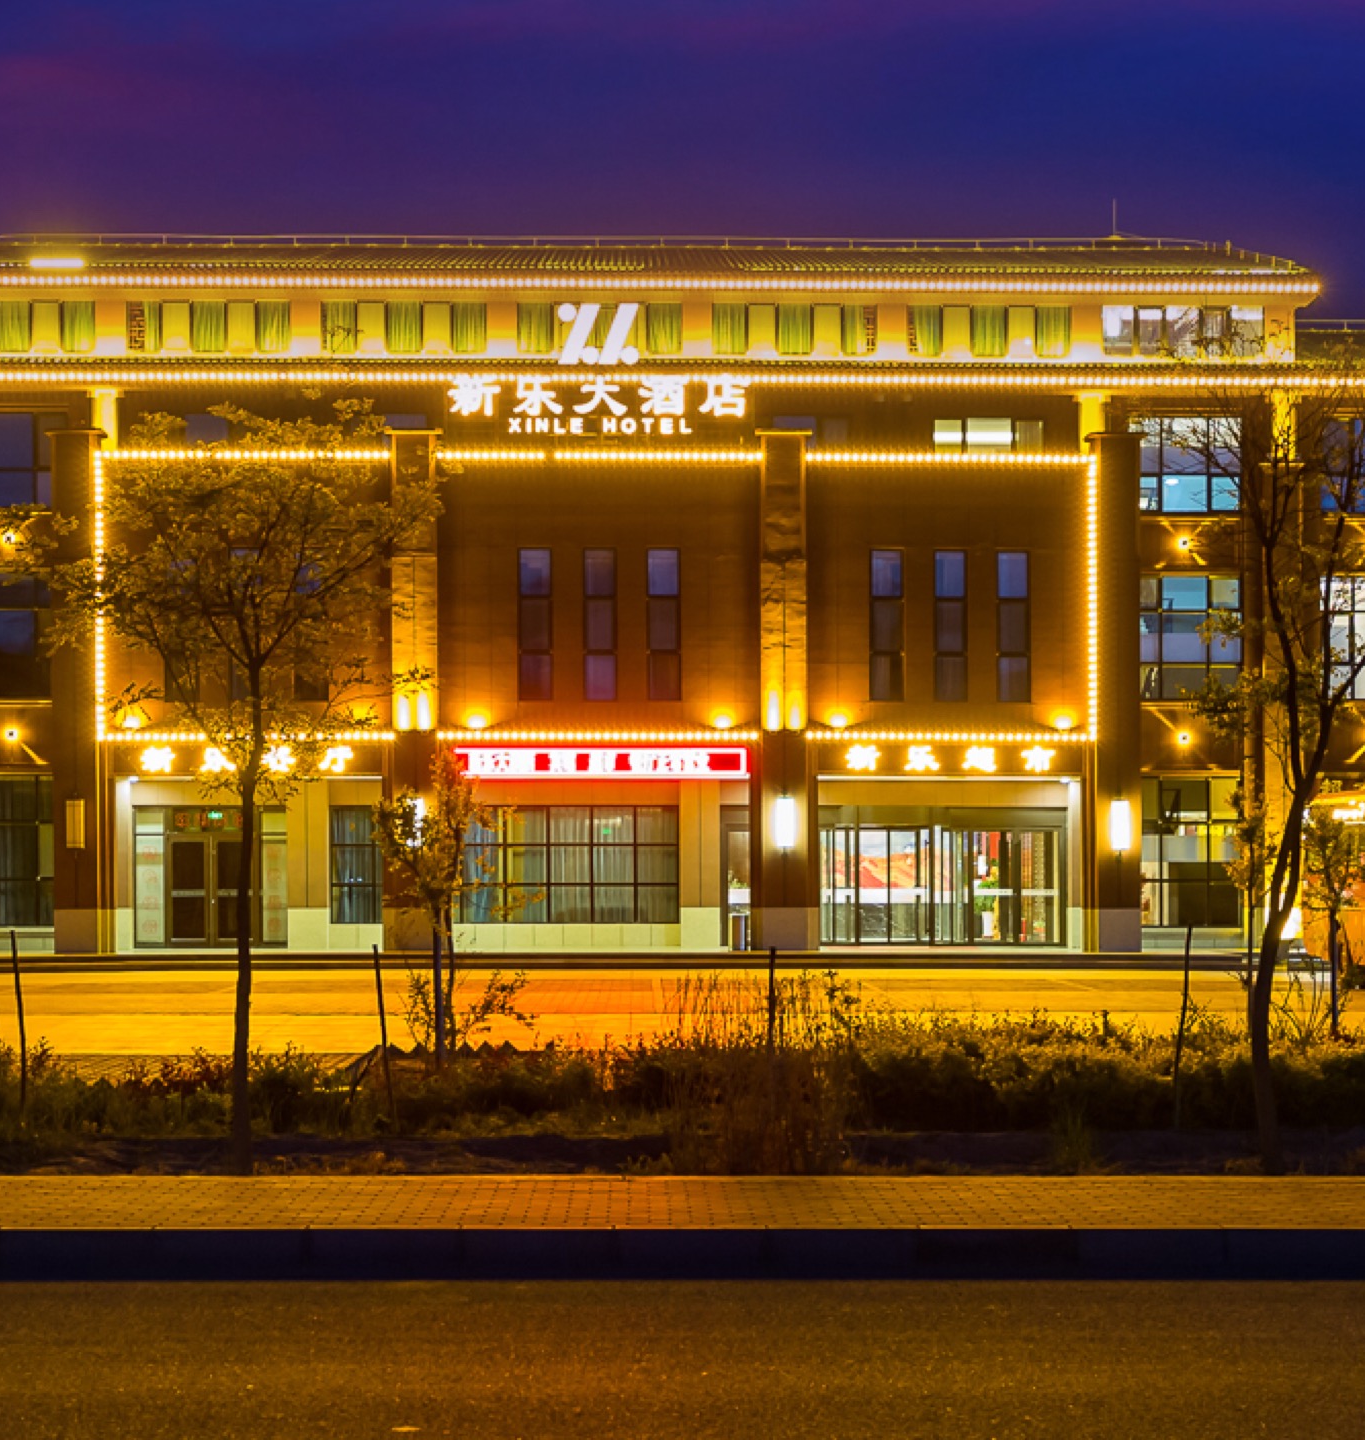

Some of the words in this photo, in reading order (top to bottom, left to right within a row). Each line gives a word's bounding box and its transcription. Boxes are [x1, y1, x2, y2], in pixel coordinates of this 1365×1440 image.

[446, 376, 751, 418] 新乐大酒店
[508, 417, 583, 435] XINLE
[602, 417, 693, 435] HOTEL
[844, 744, 1056, 773] 新乐超市
